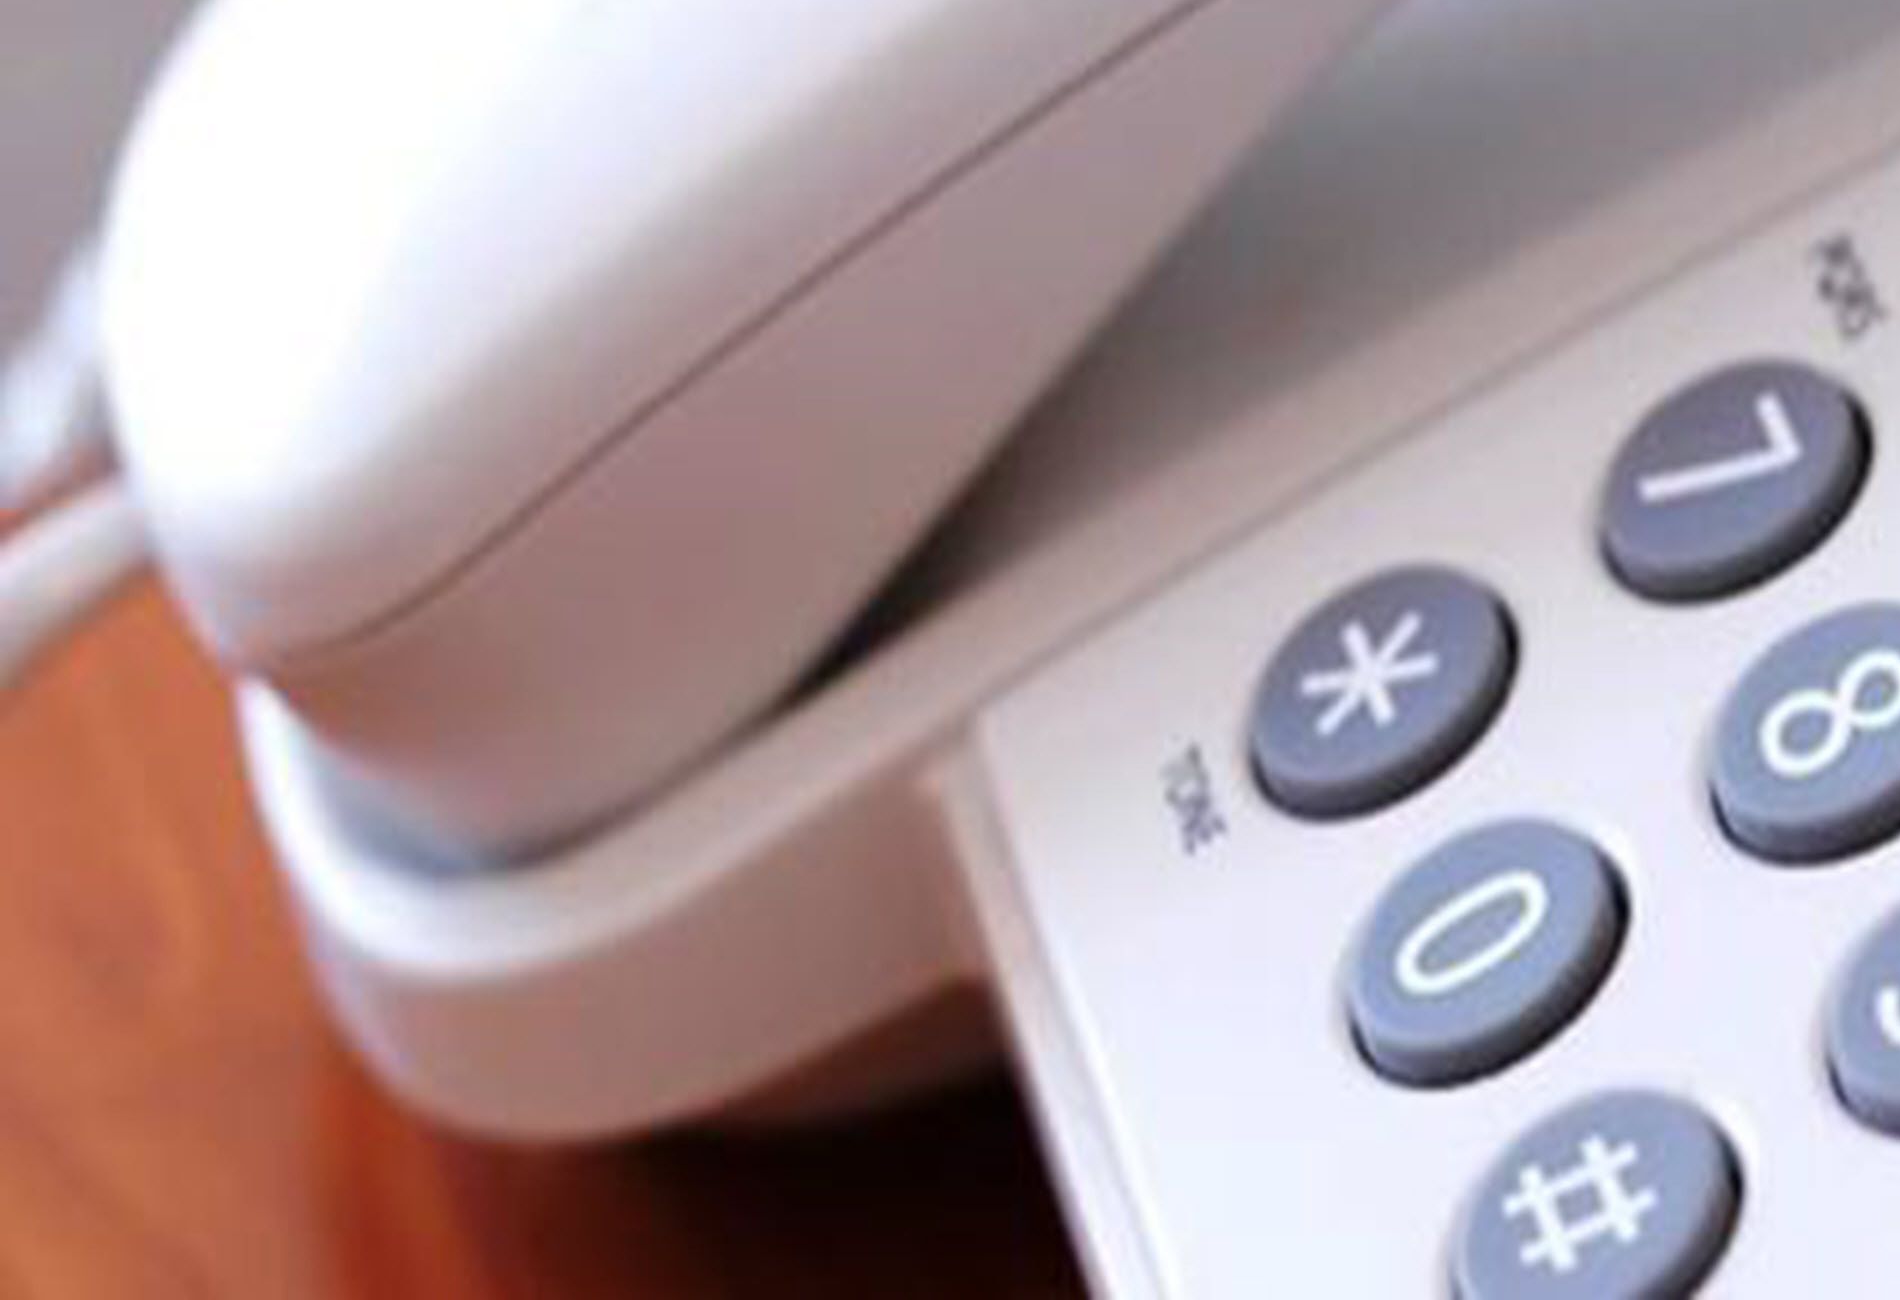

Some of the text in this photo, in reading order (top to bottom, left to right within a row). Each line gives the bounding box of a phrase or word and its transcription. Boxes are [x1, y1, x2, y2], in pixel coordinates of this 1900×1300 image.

[1639, 393, 1801, 502] 7
[1395, 869, 1547, 995] 0
[1502, 1134, 1657, 1273] #
